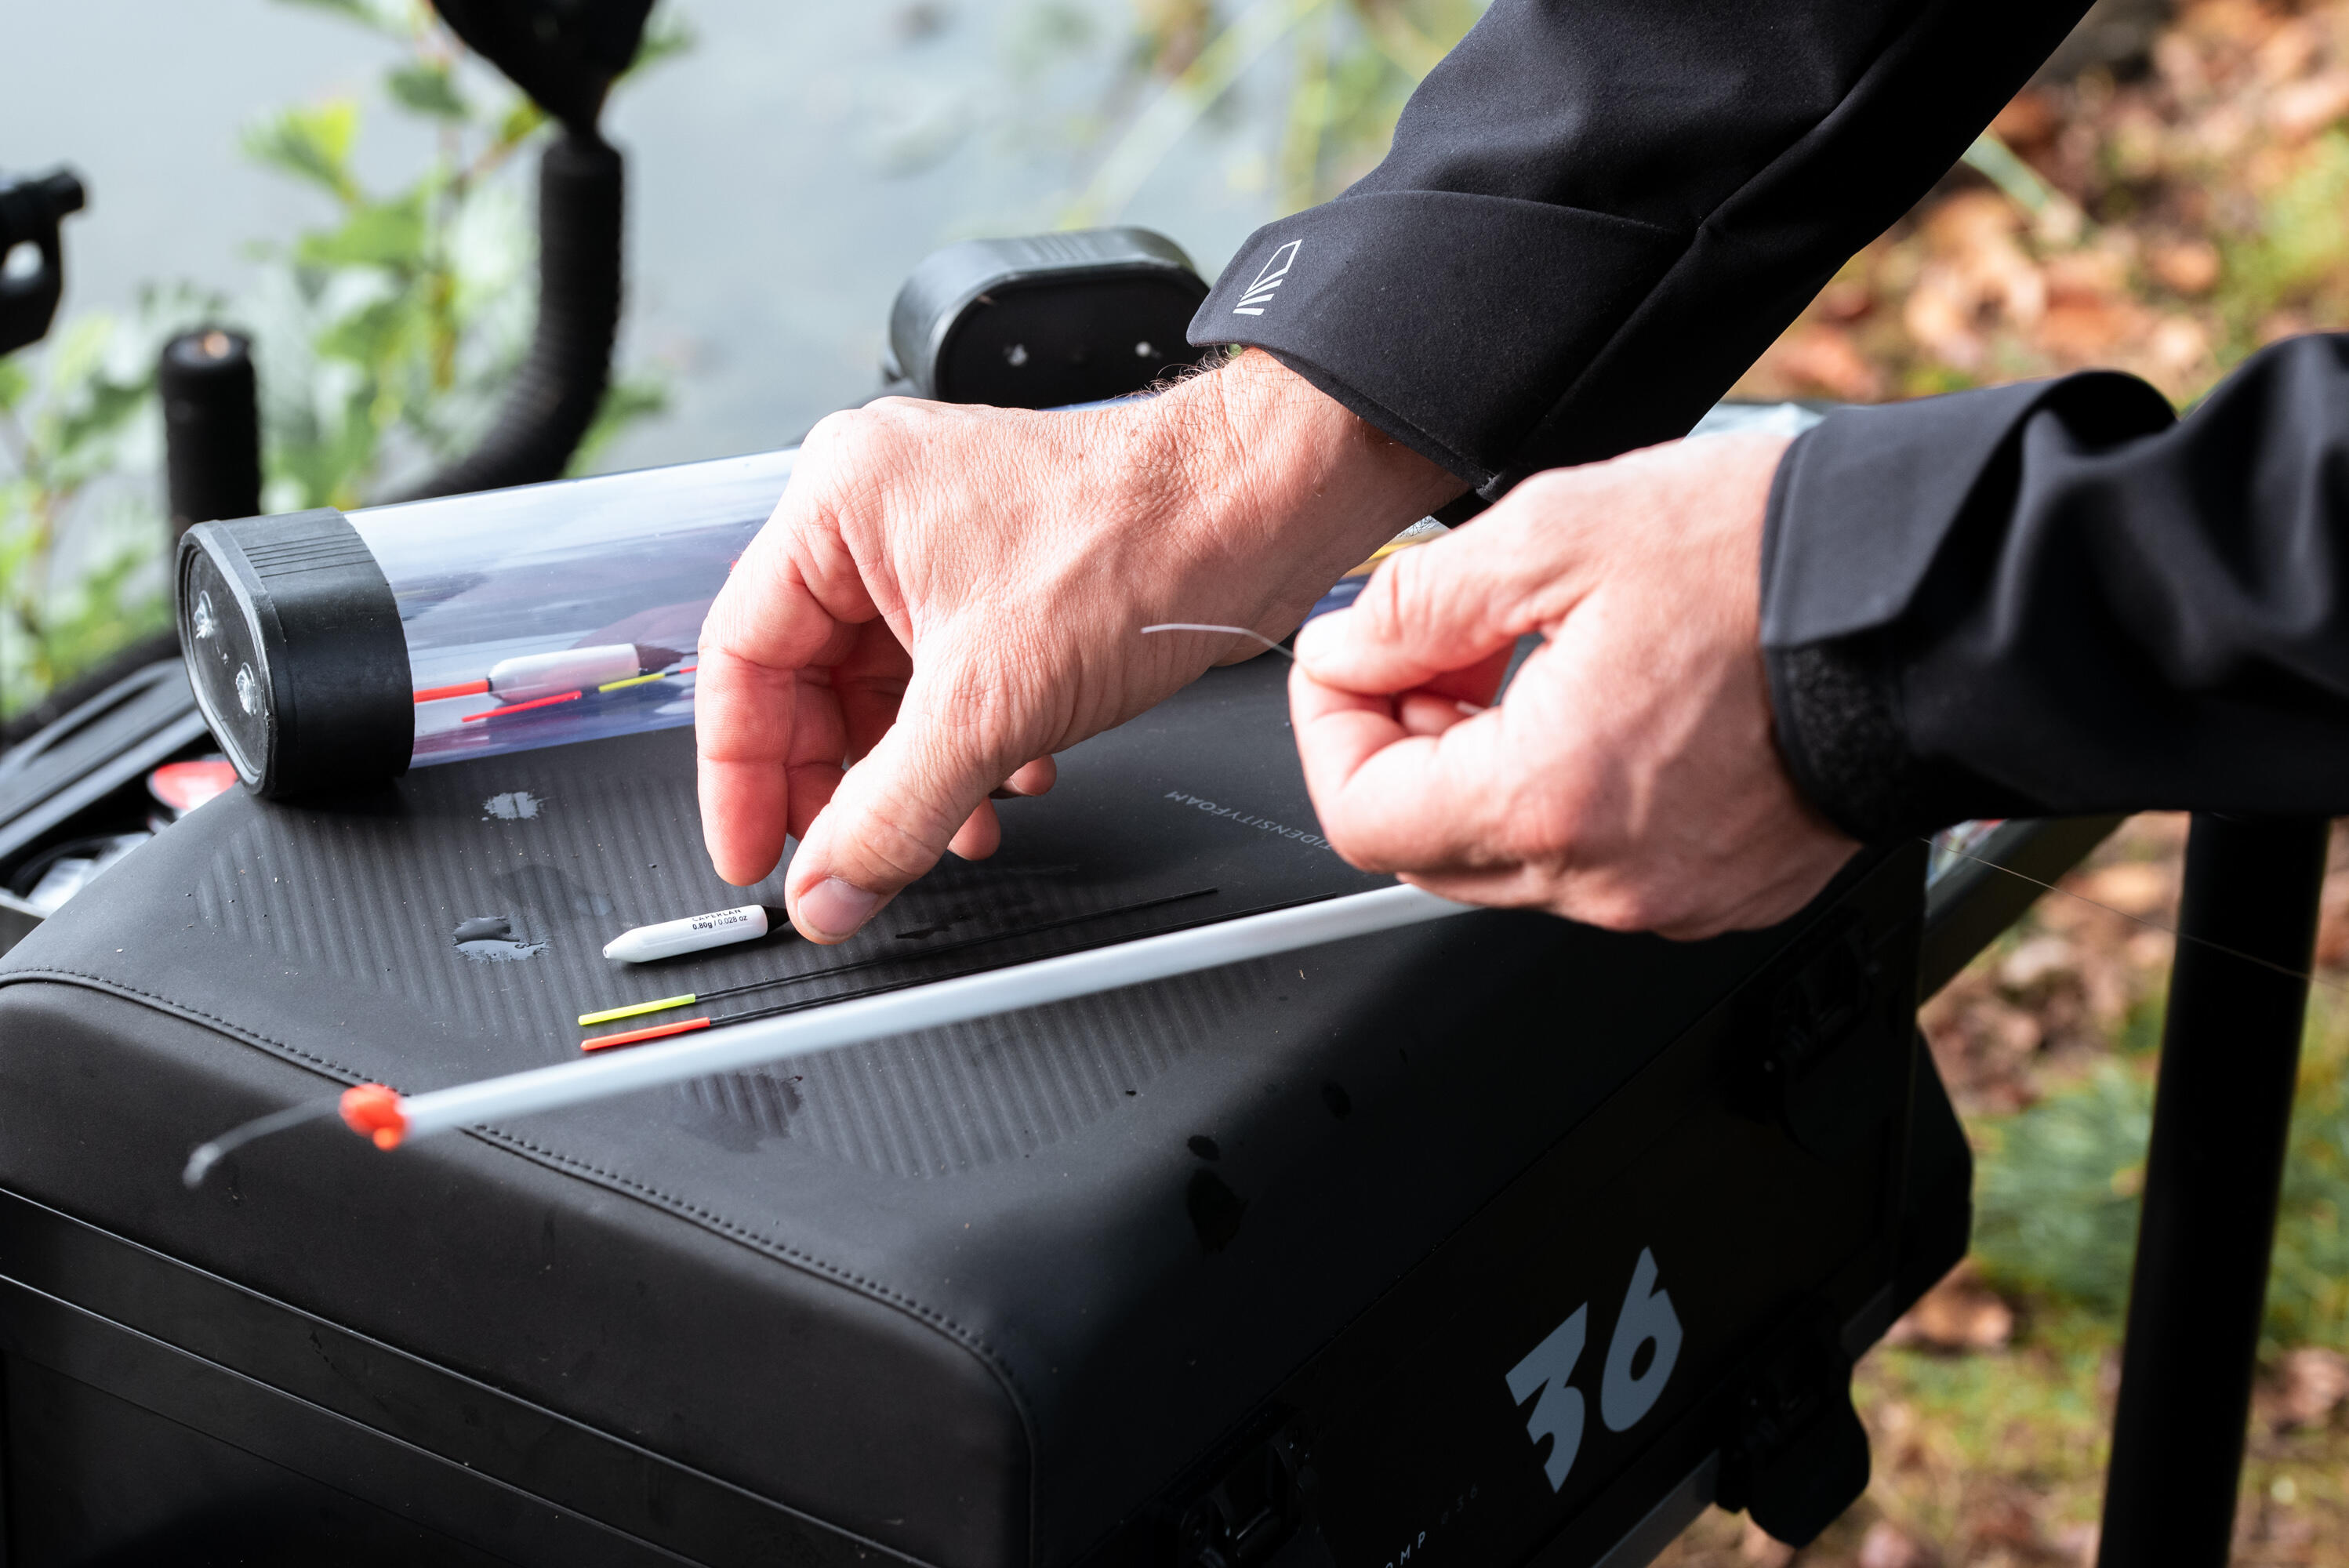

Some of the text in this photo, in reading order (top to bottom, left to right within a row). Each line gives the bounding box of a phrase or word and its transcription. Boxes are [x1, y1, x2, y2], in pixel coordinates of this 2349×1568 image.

[692, 921, 713, 930] 0.80g
[717, 916, 738, 926] 0.028
[1505, 1246, 1683, 1494] 36
